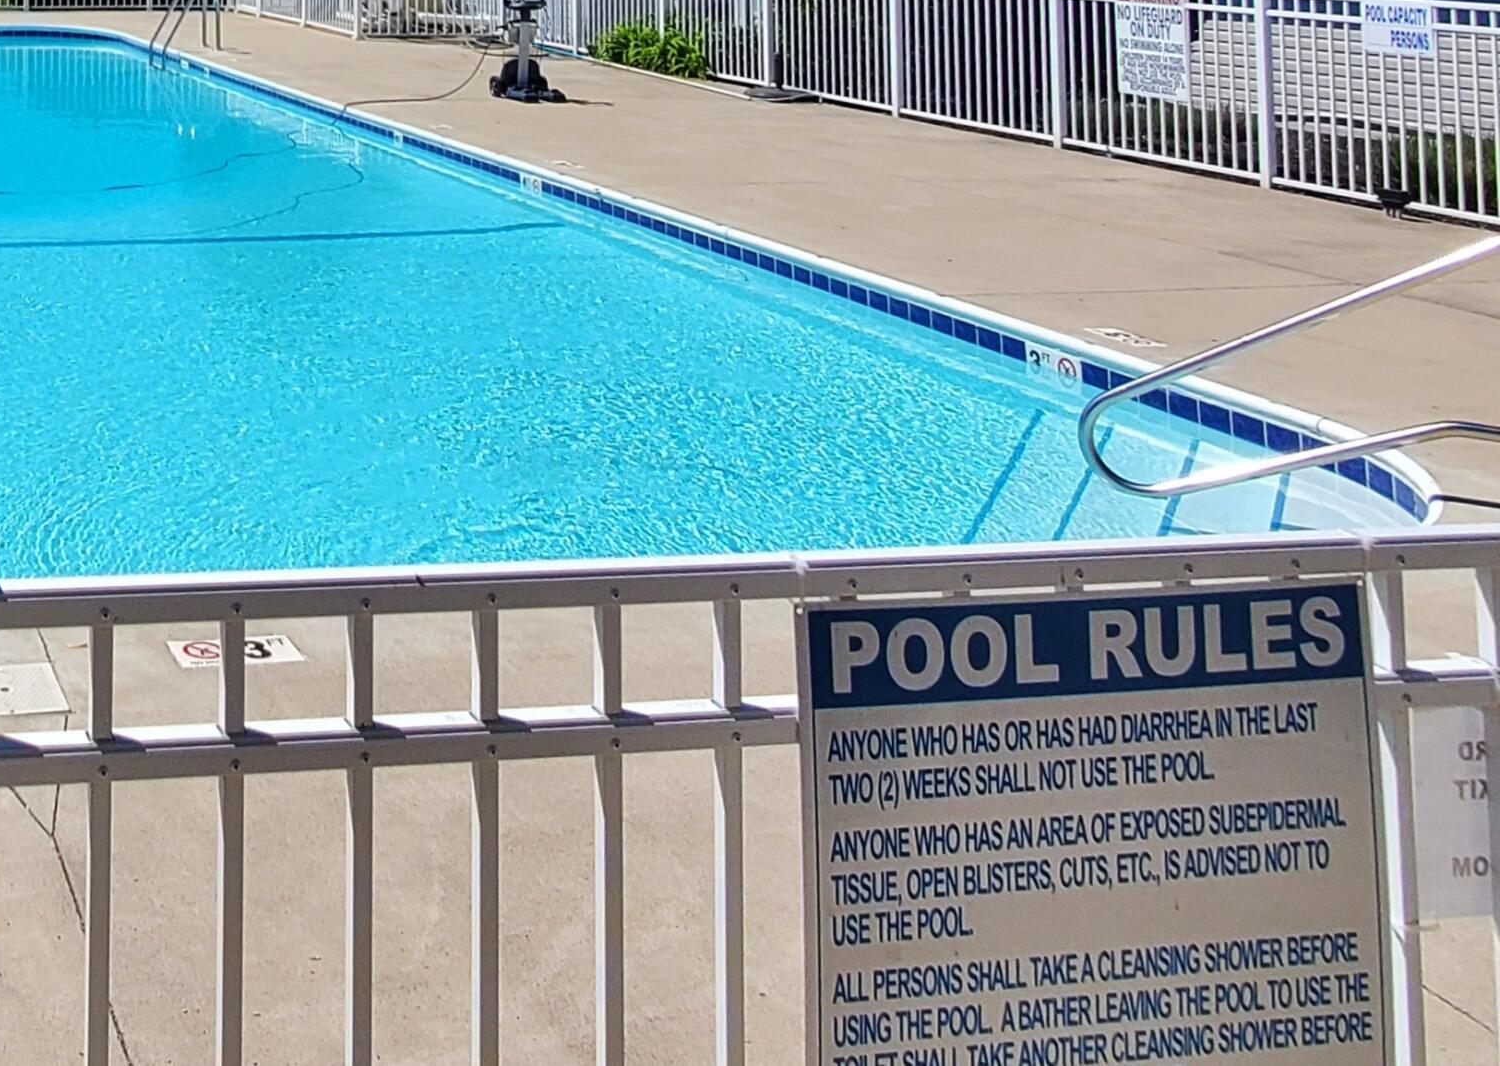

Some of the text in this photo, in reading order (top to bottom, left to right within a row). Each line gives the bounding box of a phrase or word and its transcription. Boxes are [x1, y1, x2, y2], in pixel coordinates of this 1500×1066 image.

[1117, 5, 1182, 25] NO LIFEGUARD
[1130, 22, 1171, 40] ON DUTY
[1365, 4, 1428, 26] POOL CAPACITY
[1391, 30, 1429, 50] PERSONS
[244, 638, 284, 659] 3 FT
[831, 596, 1345, 694] POOL RULES
[828, 702, 1317, 762] ANYONE WHO HAS OR HAS HAD DIARRHEA IN THE LAST
[829, 751, 1215, 810] TWO (2) WEEKS SHALL NOT USE THE POOL.
[831, 797, 1346, 863] ANYONE WHO HAS AN AREA OF EXPOSED SUBEPIDERMAL
[831, 839, 1329, 906] TISSUE, OPEN BLISTERS, CUTS, ETC., IS ADVISED NOT TO
[832, 907, 973, 946] USE THE POOL.
[833, 932, 1358, 1004] ALL PERSONS SHALL TAKE A CLEANSING SHOWER BEFORE
[833, 972, 1370, 1048] USING THE POOL. A BATHER LEAVING THE POOL TO USE THE
[1020, 1034, 1108, 1066] ANOTHER
[1111, 1025, 1214, 1062] CLEANSING
[1218, 1018, 1298, 1053] SHOWER
[1302, 1012, 1373, 1046] BEFORE
